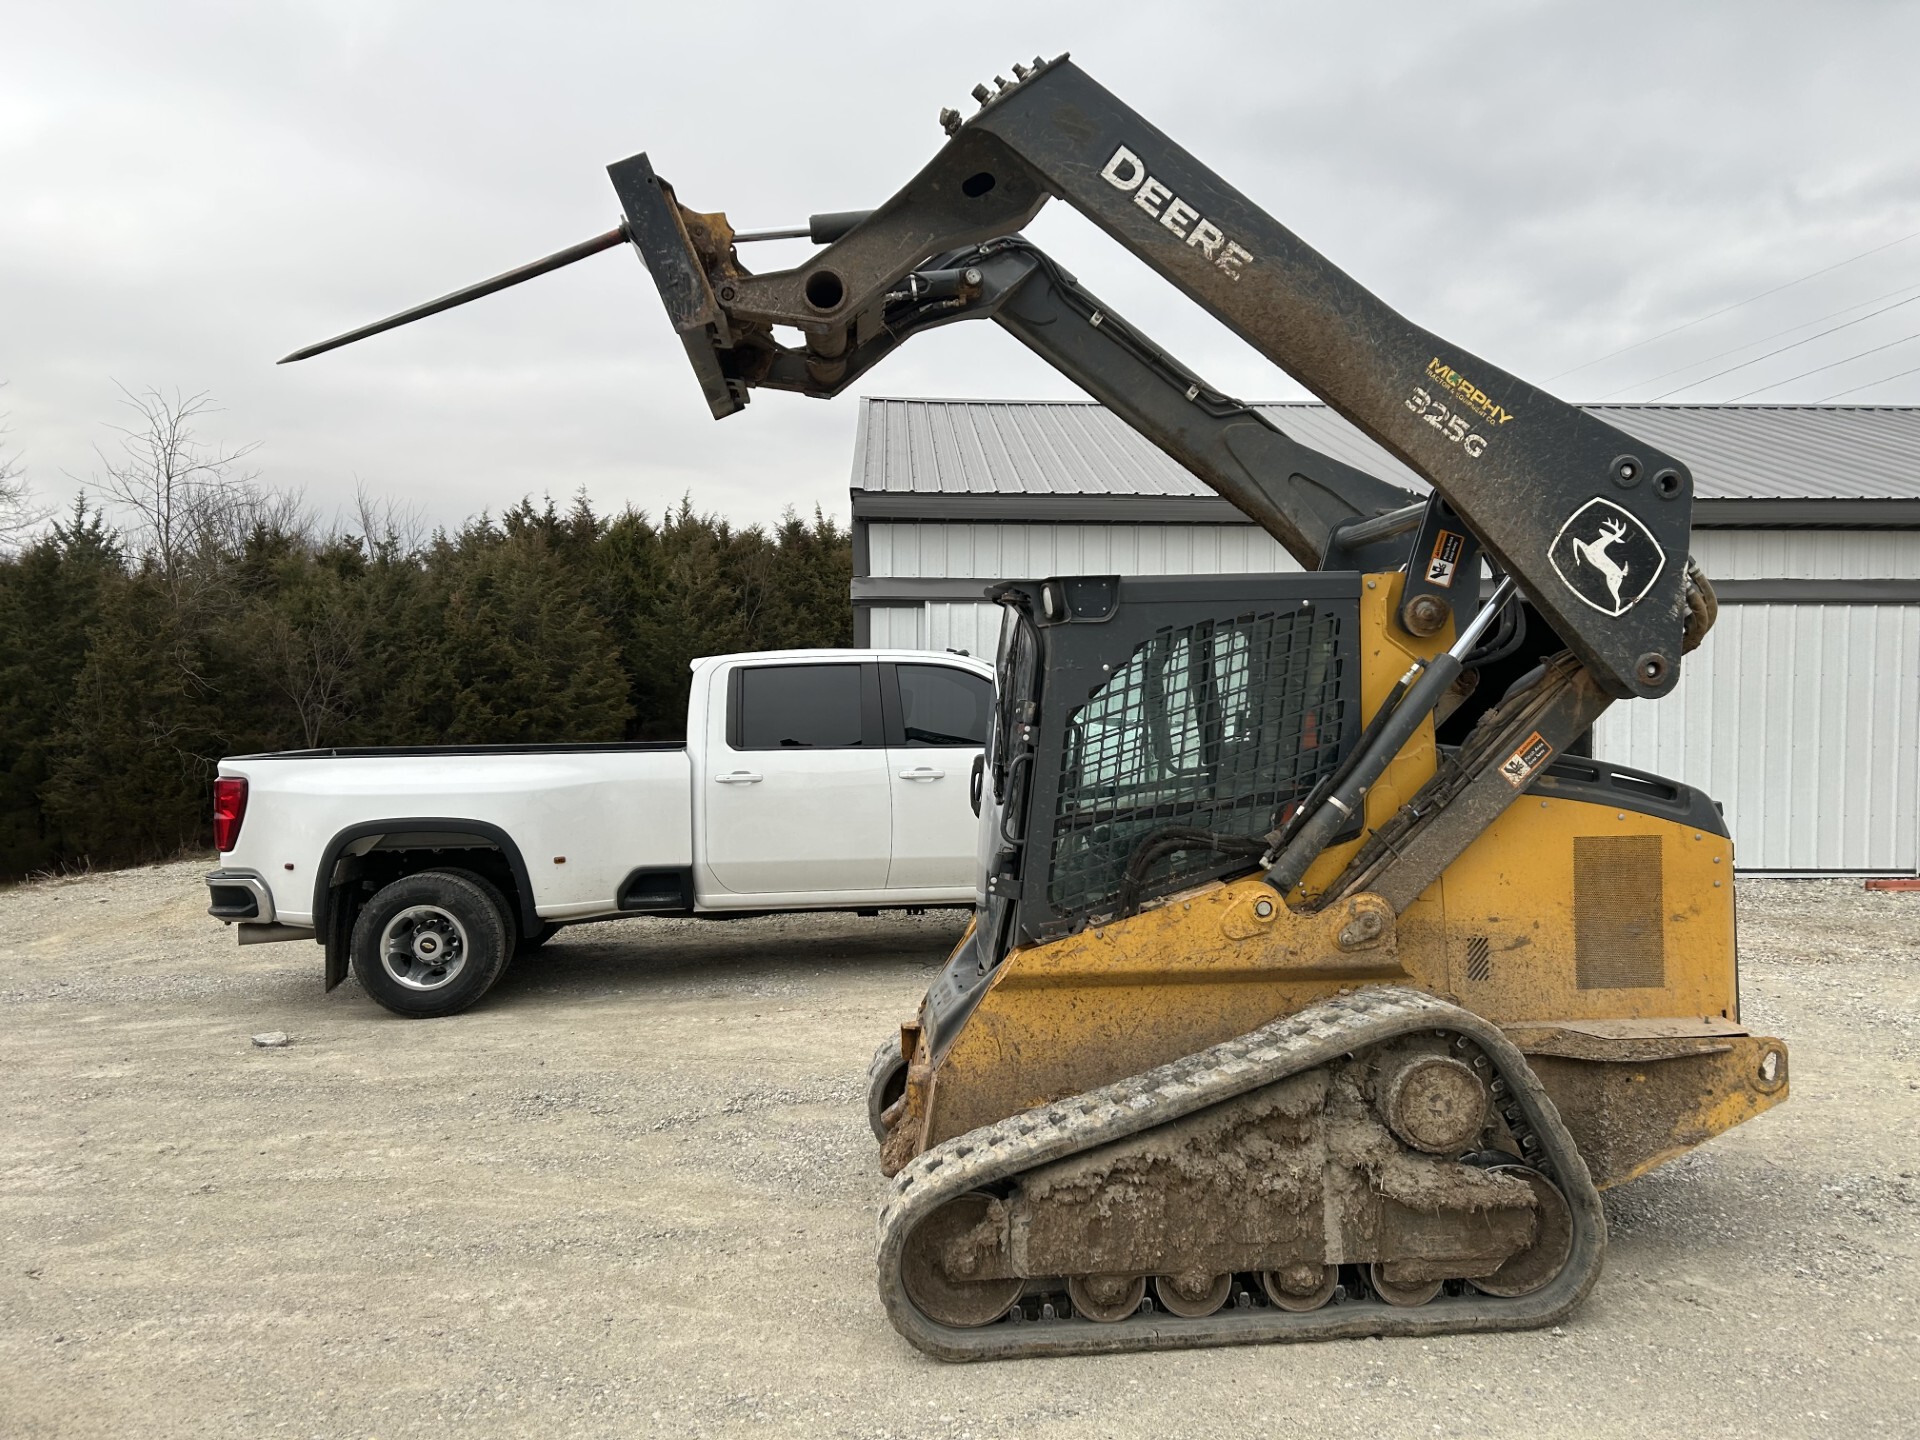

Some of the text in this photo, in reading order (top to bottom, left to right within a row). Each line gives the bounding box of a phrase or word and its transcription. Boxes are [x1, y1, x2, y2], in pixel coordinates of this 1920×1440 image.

[1100, 144, 1254, 281] DEERE
[1405, 386, 1488, 458] 325G
[1425, 368, 1451, 391] TRACTOR
[1456, 392, 1486, 418] EQUIPMENT
[1428, 357, 1514, 424] MURPHY
